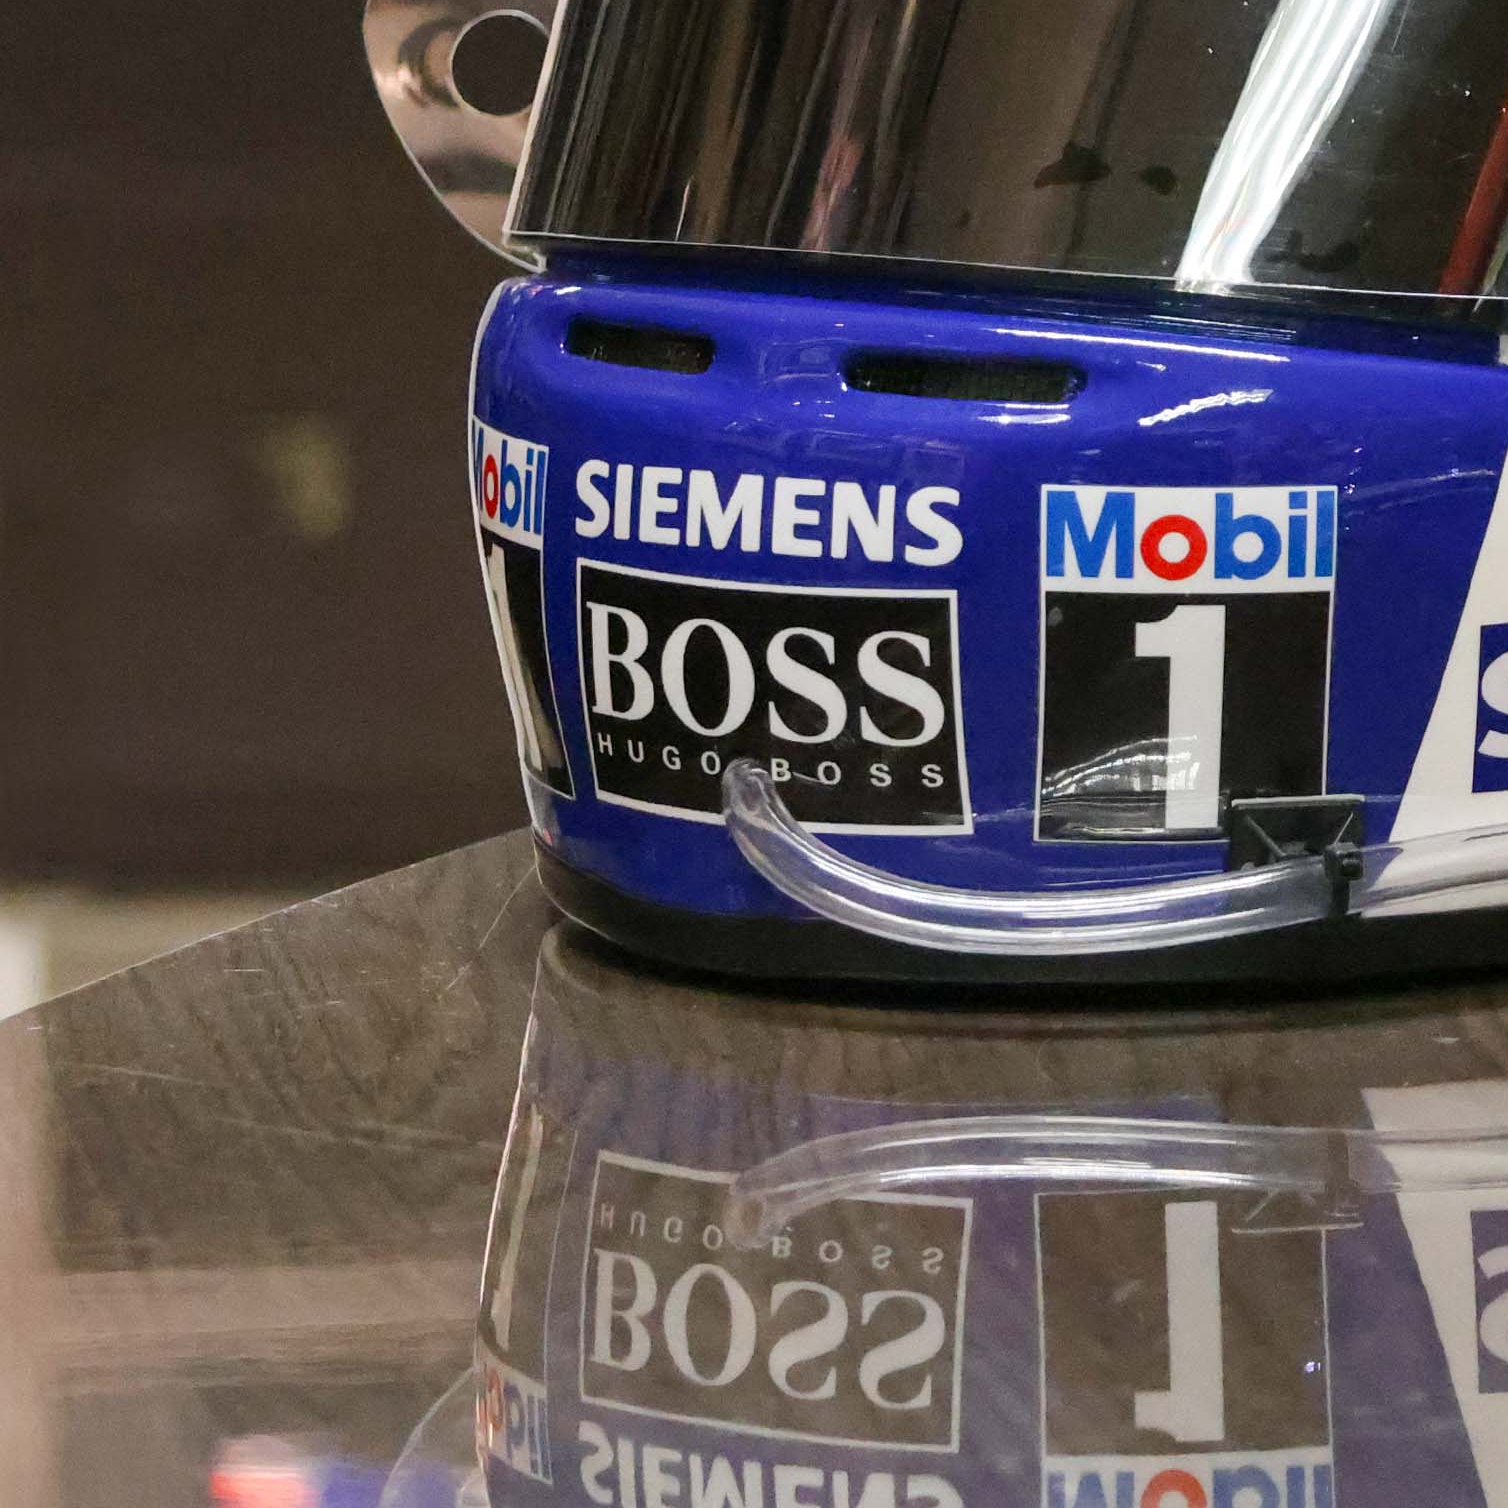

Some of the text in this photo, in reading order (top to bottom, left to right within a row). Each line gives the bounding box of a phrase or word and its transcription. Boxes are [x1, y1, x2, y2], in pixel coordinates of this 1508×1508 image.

[575, 459, 964, 567] SIEMENS
[1046, 490, 1334, 582] Mobil
[586, 600, 946, 748] BOSS
[1134, 604, 1226, 830] 1
[600, 733, 945, 789] HUGO BOSS
